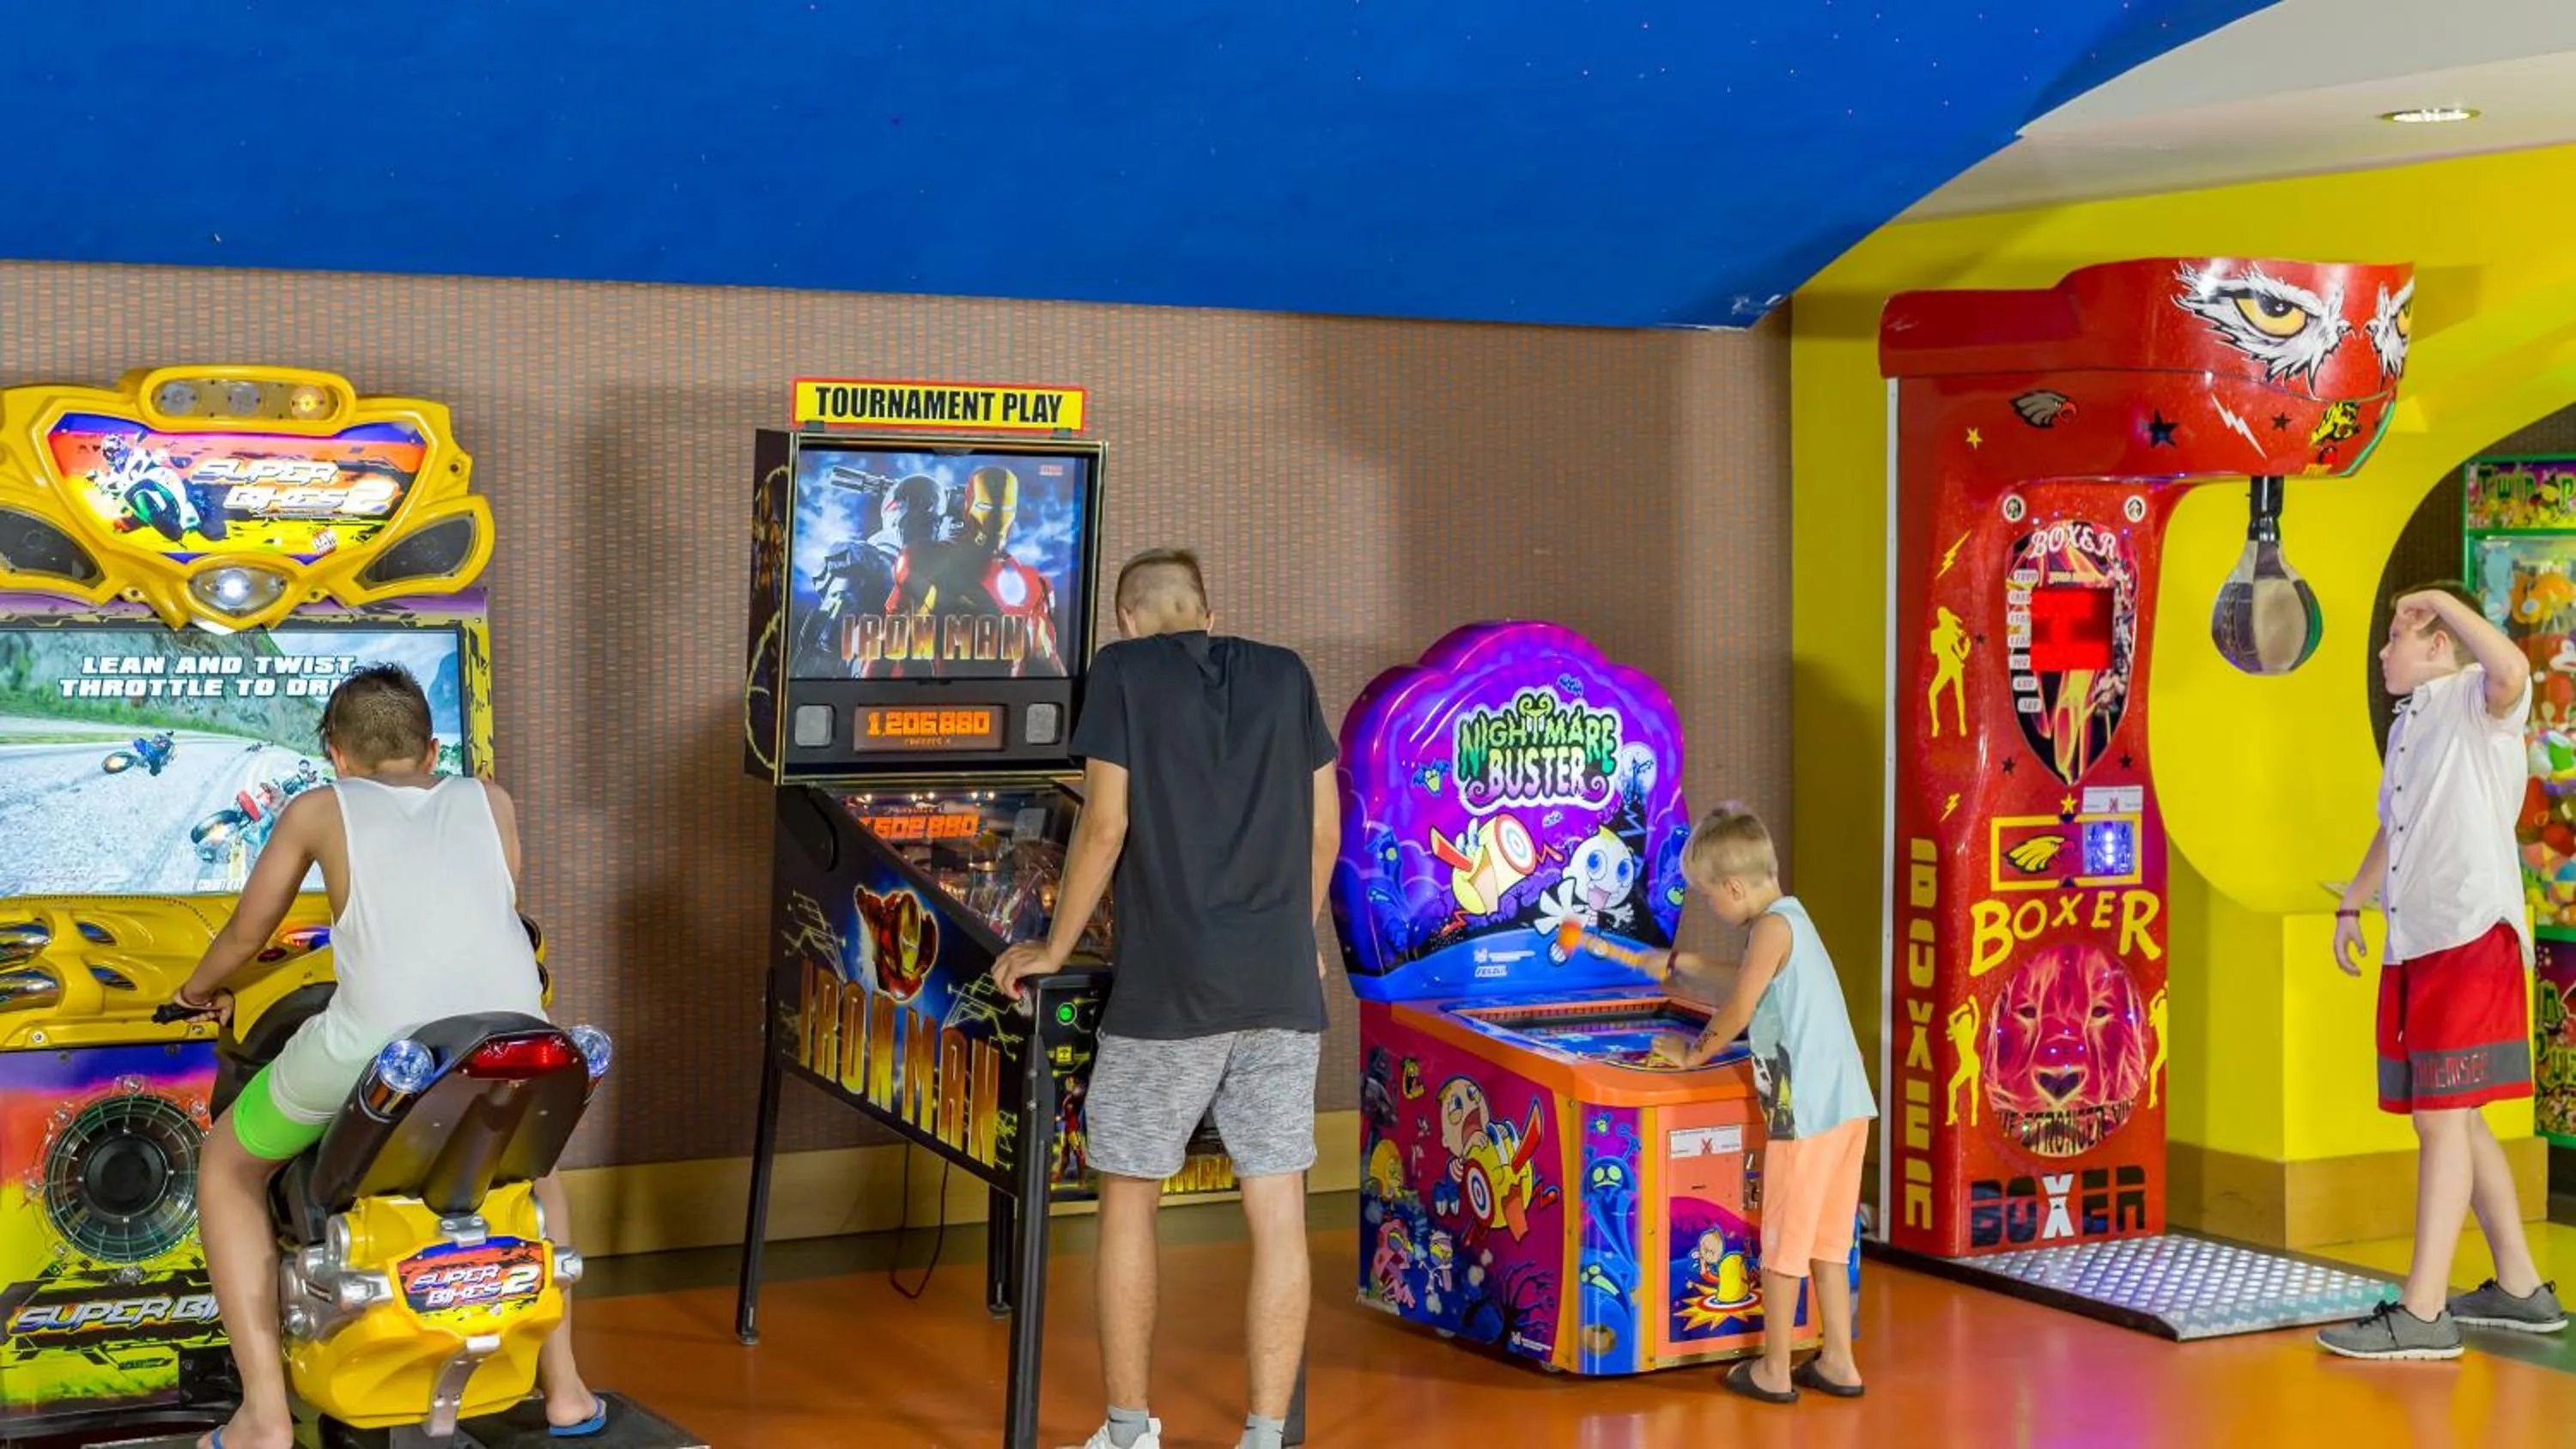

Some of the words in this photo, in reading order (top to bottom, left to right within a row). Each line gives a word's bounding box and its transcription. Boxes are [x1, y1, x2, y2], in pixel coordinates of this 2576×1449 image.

[816, 386, 996, 421] TOURNAMENT
[1001, 392, 1063, 423] PLAY
[191, 458, 338, 484] SUPER
[343, 473, 399, 514] 2
[2027, 524, 2117, 561] BOXER
[841, 614, 935, 661] IRON
[943, 614, 1028, 661] MAN
[81, 657, 166, 674] LEAN
[174, 657, 244, 674] AND
[254, 657, 357, 674] TWIST
[58, 679, 225, 697] THROTTLE
[236, 679, 276, 697] TO
[285, 679, 345, 697] DRI
[1459, 694, 1616, 781] NIGHTMARE
[1483, 745, 1590, 801] BUSTER
[1969, 889, 2162, 978] BOXER
[1905, 837, 1938, 1231] BOXER
[799, 957, 895, 1113] IRON
[901, 1005, 1000, 1169] MAN
[1970, 1165, 2146, 1247] BOXER
[410, 1264, 501, 1292] SUPER
[426, 1282, 503, 1307] BIKES
[501, 1264, 540, 1294] 2
[15, 1298, 173, 1331] SUPER
